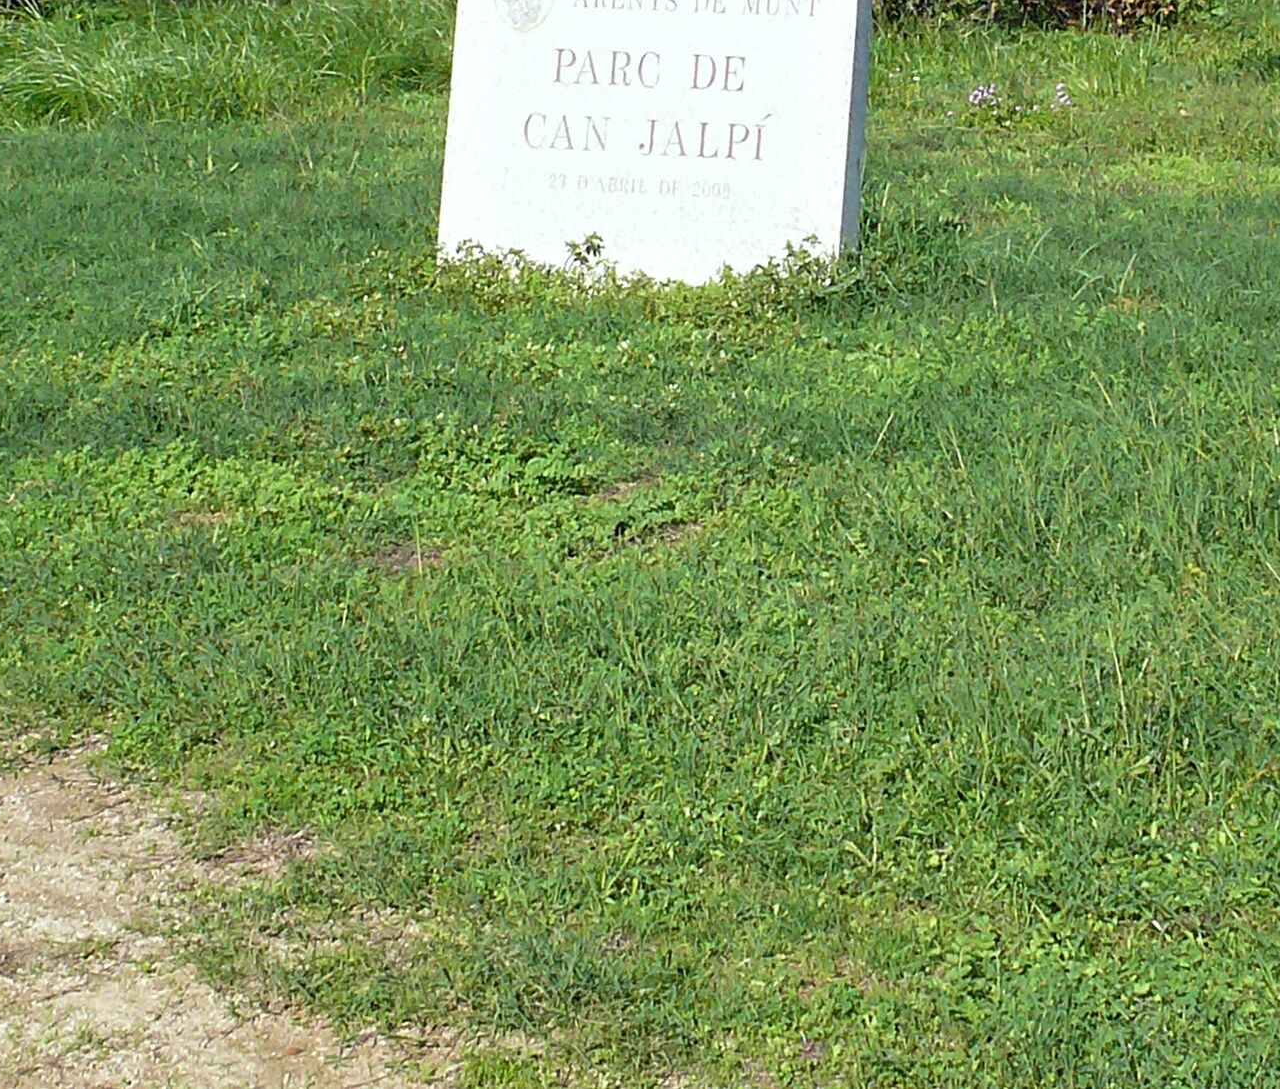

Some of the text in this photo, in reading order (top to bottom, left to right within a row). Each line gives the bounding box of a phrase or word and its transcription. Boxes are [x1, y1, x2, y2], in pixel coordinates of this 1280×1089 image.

[553, 47, 747, 92] PARC DE
[523, 111, 773, 161] CAN JALPÍ
[659, 178, 682, 197] DE
